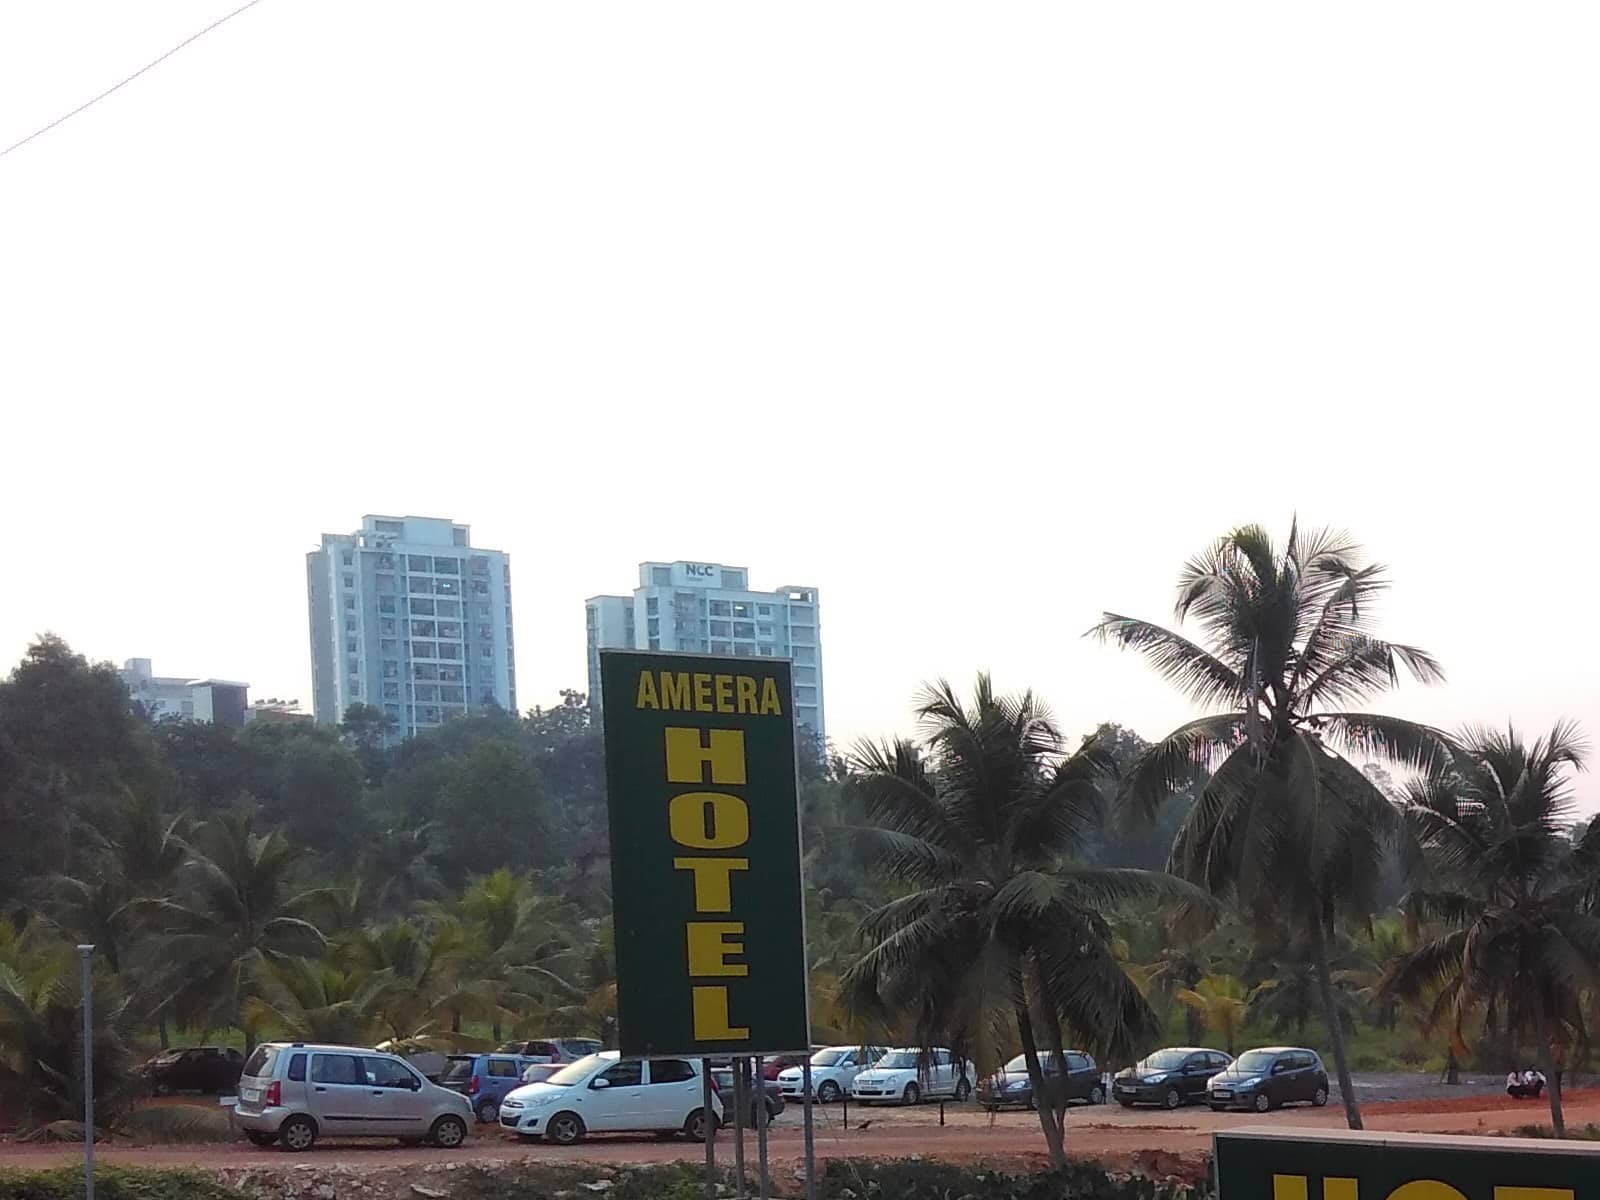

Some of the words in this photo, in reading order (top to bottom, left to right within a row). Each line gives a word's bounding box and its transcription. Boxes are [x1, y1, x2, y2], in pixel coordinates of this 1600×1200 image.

[686, 564, 713, 576] NCC
[636, 671, 782, 716] AMEERA
[663, 726, 750, 1042] HOTEL
